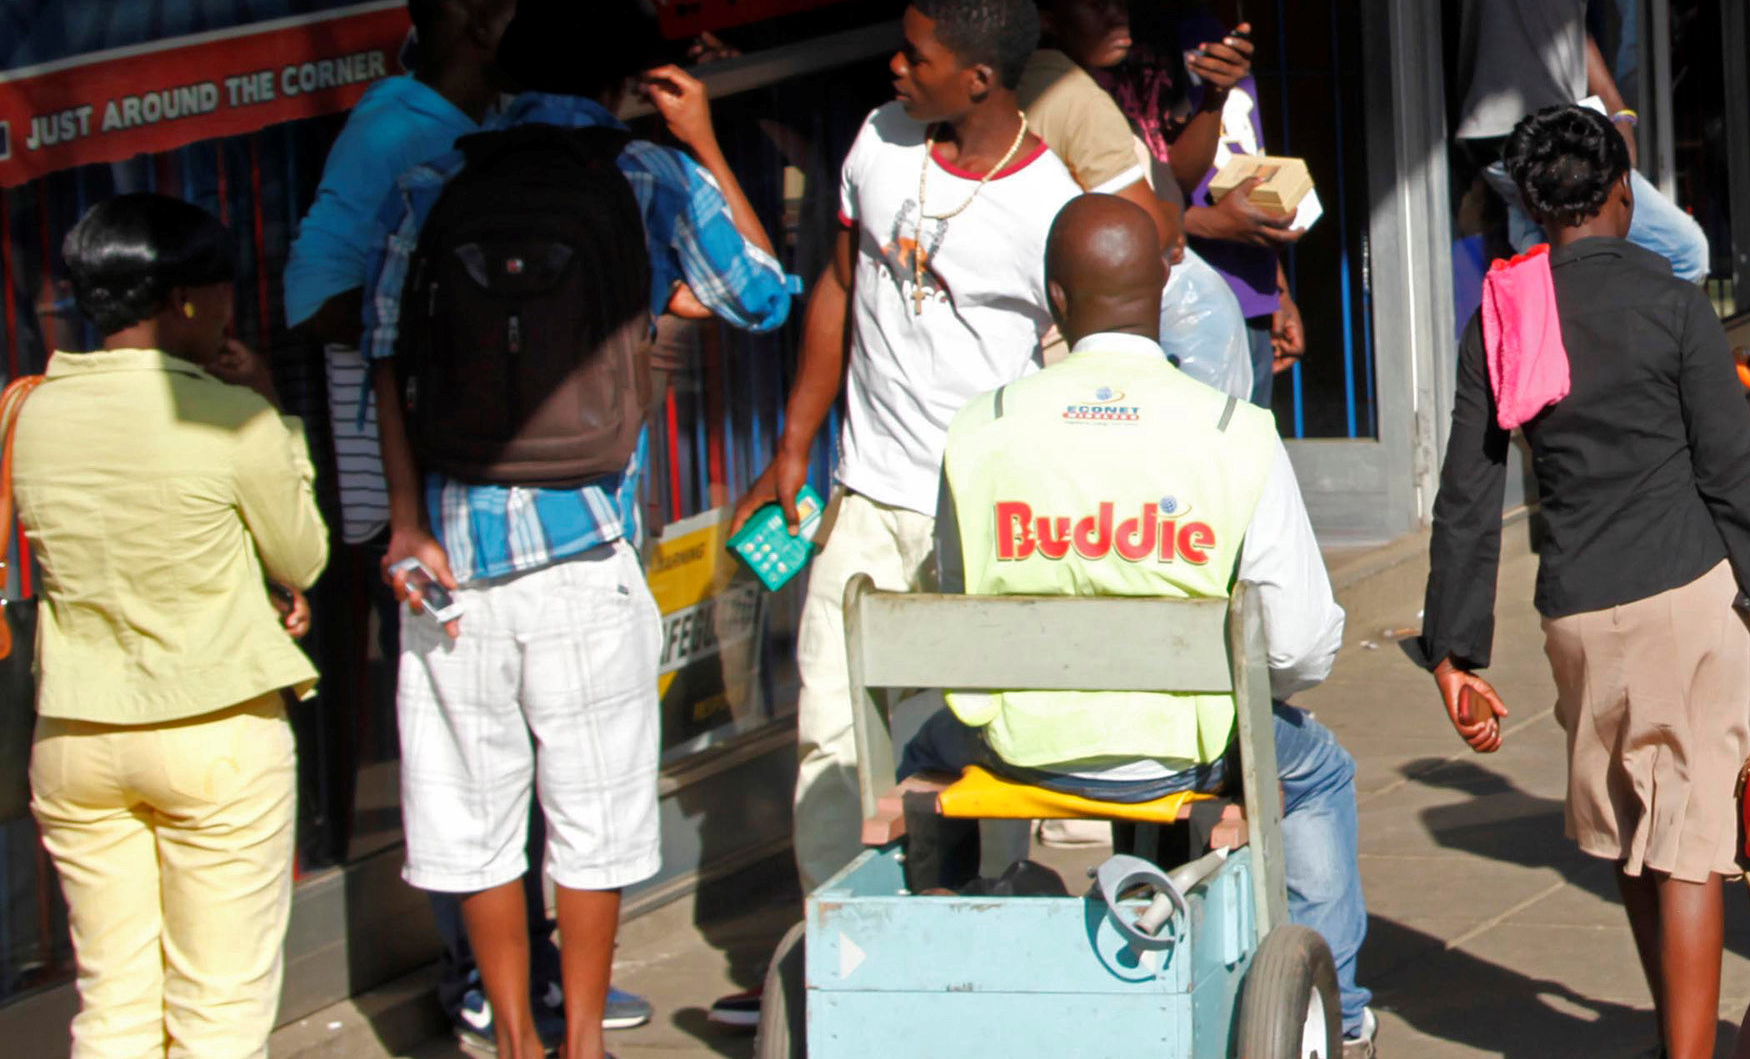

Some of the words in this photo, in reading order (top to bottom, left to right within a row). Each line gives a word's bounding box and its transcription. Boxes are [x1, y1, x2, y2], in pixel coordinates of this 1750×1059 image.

[26, 105, 94, 152] JUST
[102, 81, 219, 132] AROUND
[225, 71, 276, 107] THE
[281, 49, 386, 97] CORNER
[1067, 405, 1140, 414] ECONET
[994, 498, 1216, 566] Buddie
